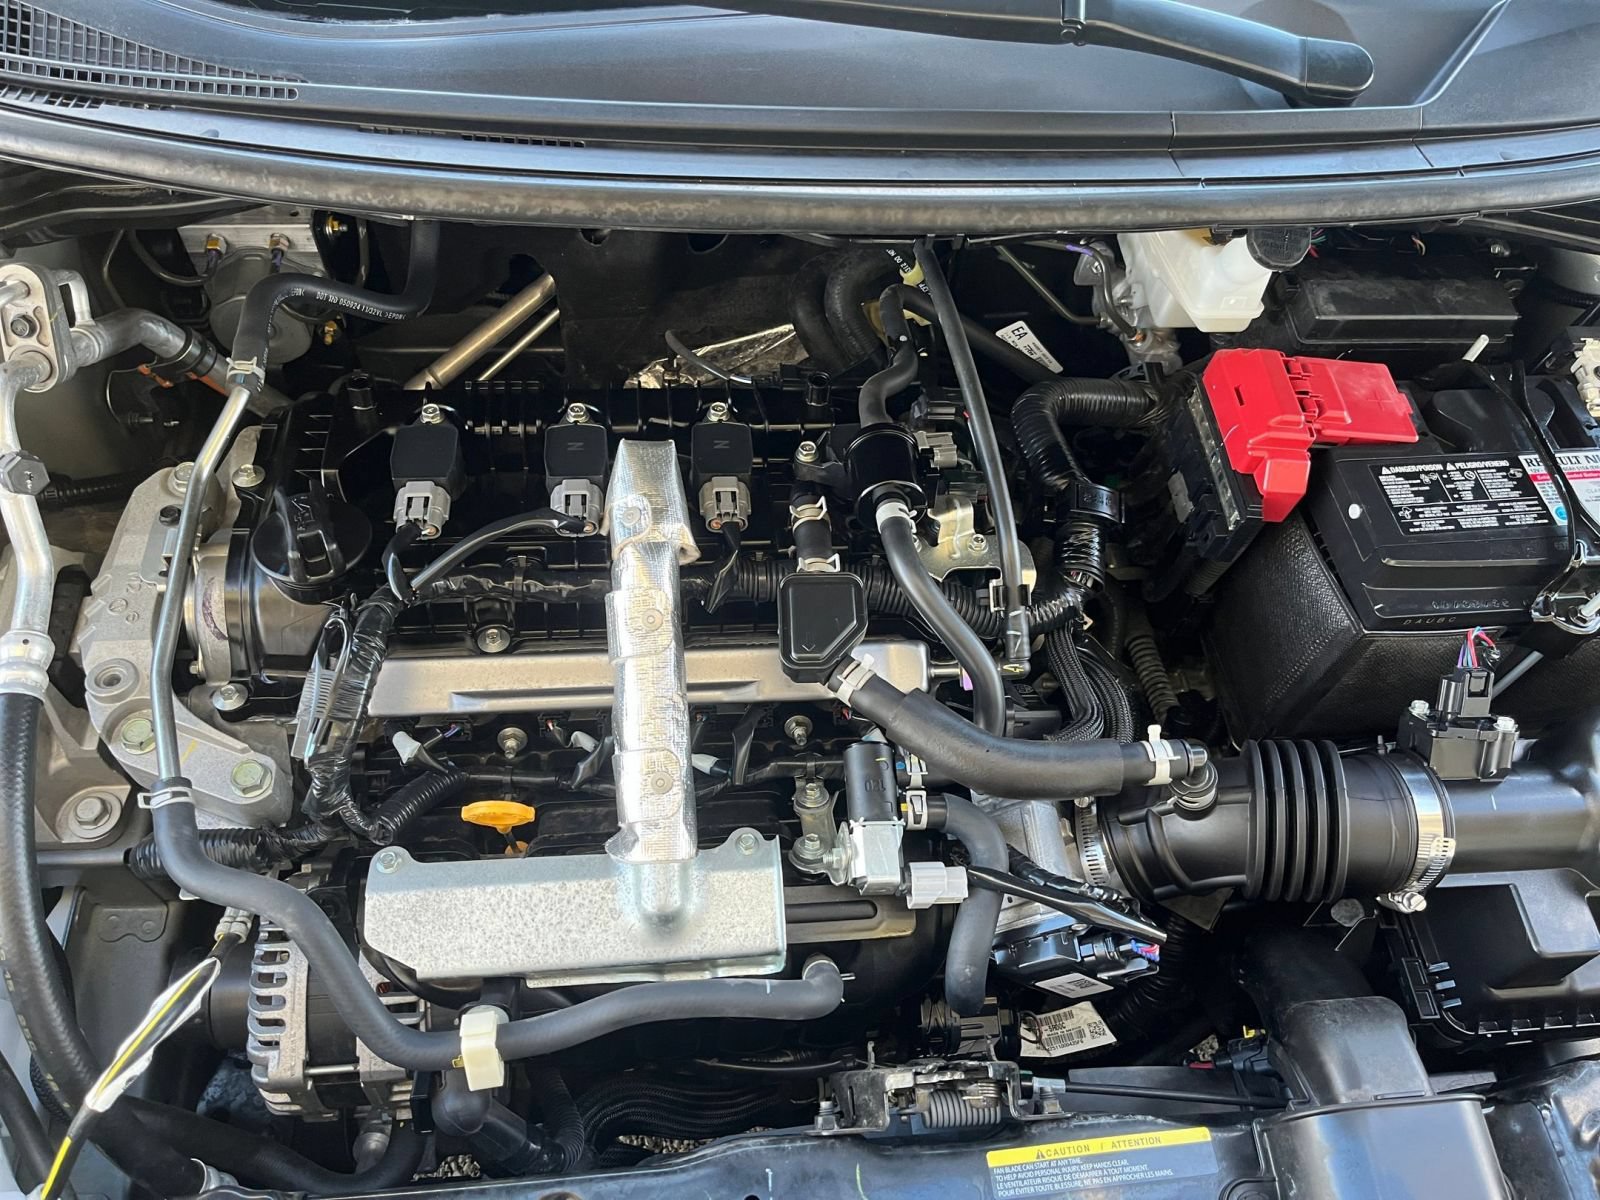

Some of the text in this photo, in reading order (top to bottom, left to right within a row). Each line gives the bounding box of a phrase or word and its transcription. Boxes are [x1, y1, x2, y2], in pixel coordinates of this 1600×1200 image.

[1011, 326, 1028, 341] EA
[1389, 459, 1510, 474] DANGER/POISON PELIGRO/VENENO
[1046, 1143, 1091, 1158] CAUTION
[1111, 1136, 1162, 1149] ATTENTION
[995, 1174, 1003, 1182] TO
[1004, 1173, 1017, 1181] HELP
[1017, 1171, 1034, 1180] AVOID
[1034, 1168, 1061, 1177] PERSONAL
[1080, 1163, 1093, 1171] KEEP
[1093, 1161, 1112, 1169] HANDS
[1004, 1165, 1022, 1173] BLADE
[1022, 1164, 1034, 1172] CAN
[1034, 1162, 1050, 1170] START
[1057, 1159, 1069, 1167] ANY
[998, 1189, 1015, 1198] POUR
[1035, 1183, 1054, 1192] TOUTE
[1092, 1177, 1103, 1185] PAS
[1103, 1175, 1112, 1183] EN
[1112, 1171, 1145, 1182] APPROCHER
[1004, 1177, 1042, 1189] VENTILATEUR
[1042, 1175, 1063, 1184] RISQUE
[1063, 1173, 1072, 1181] DE
[1108, 1167, 1122, 1175] TOUT
